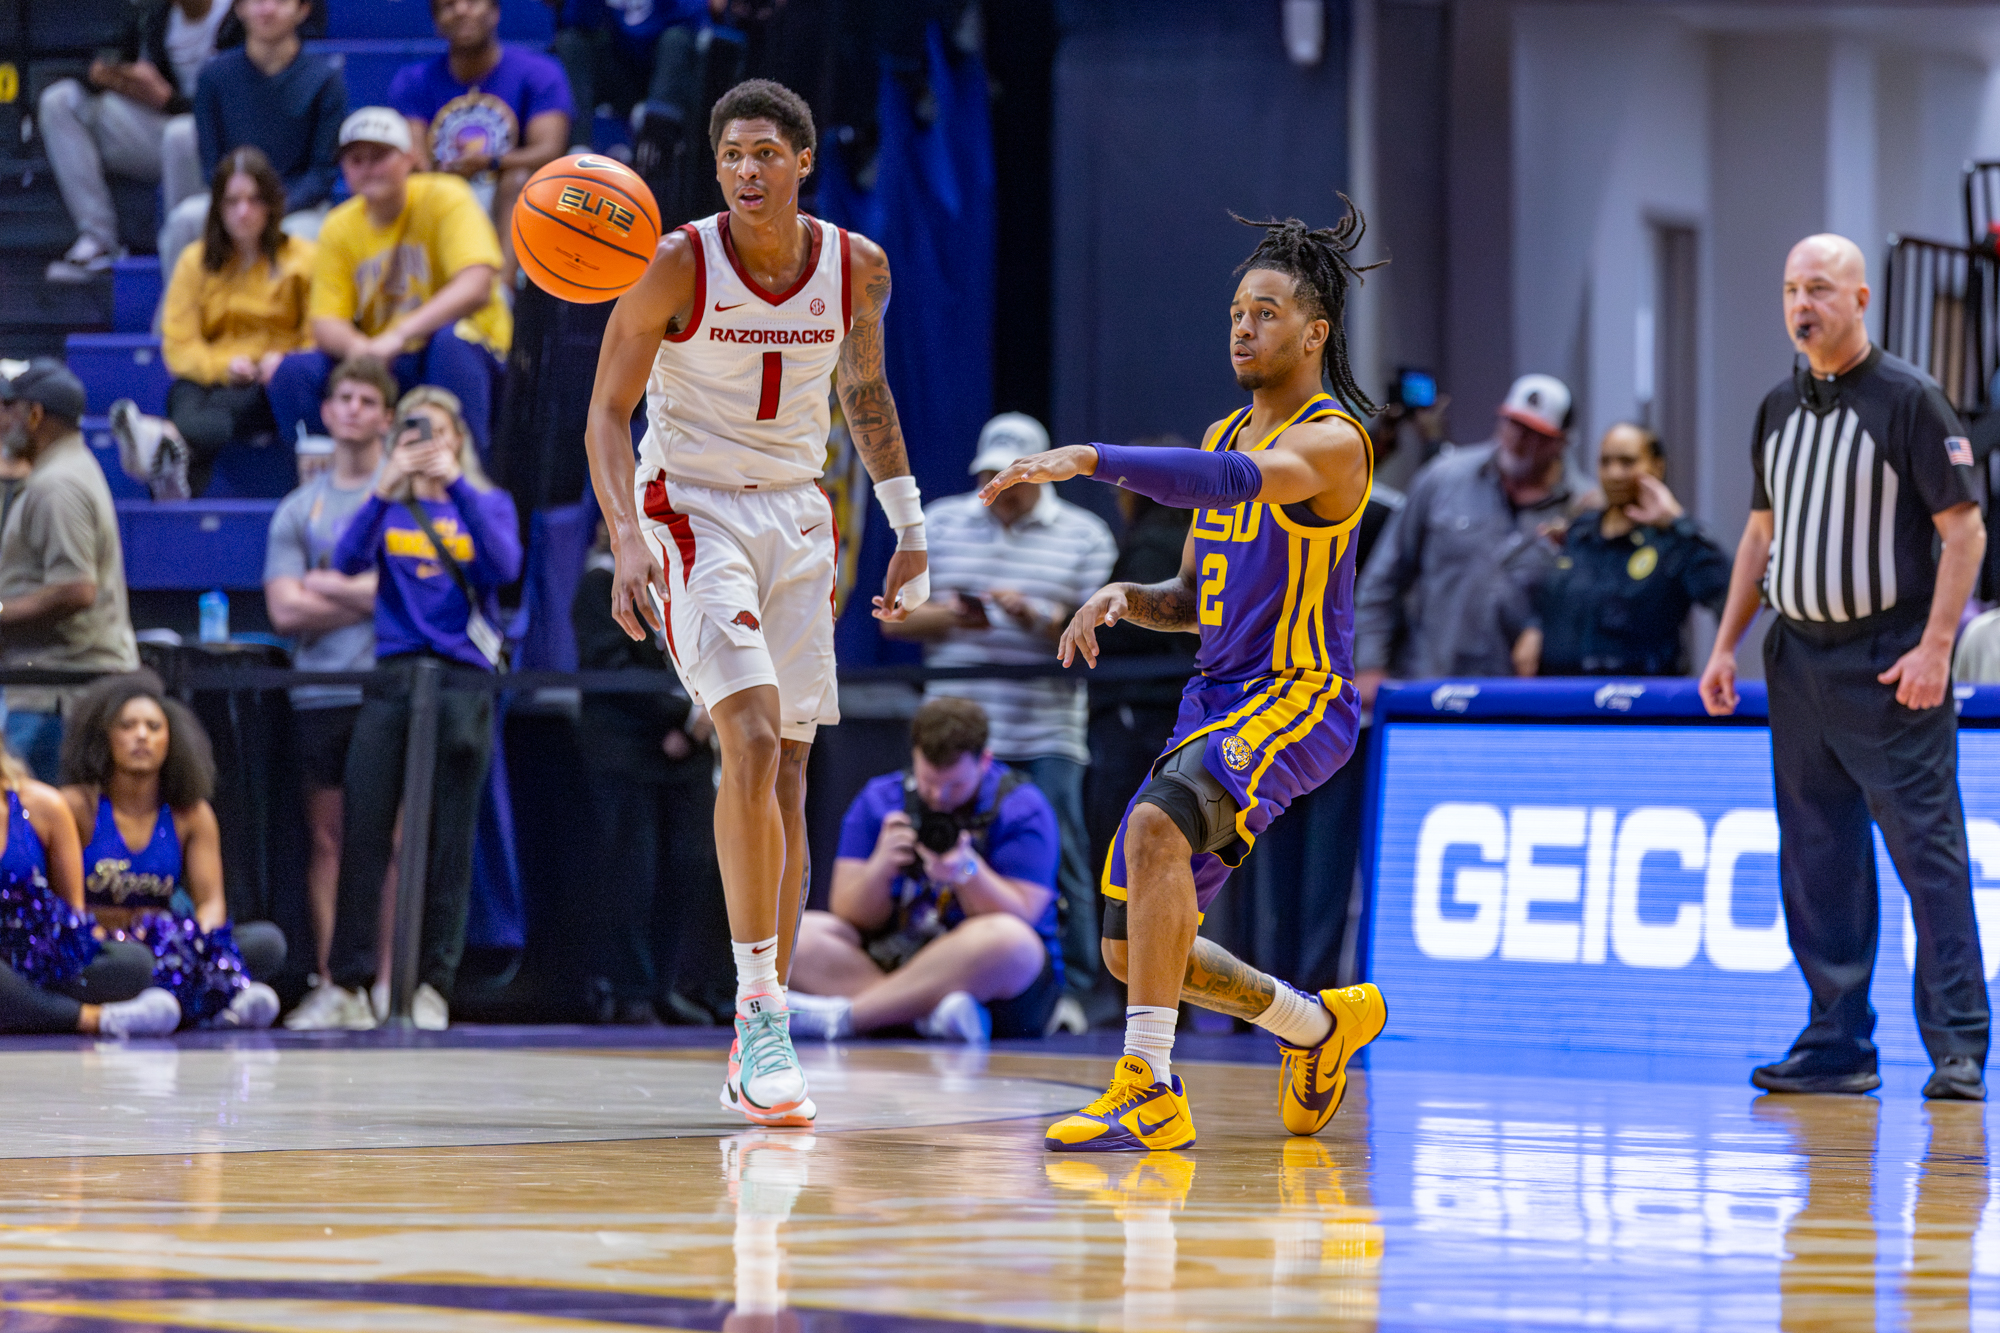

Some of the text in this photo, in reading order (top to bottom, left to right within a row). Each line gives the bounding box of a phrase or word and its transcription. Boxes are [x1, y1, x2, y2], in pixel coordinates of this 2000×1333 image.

[558, 184, 636, 232] ELITE
[810, 298, 825, 316] SEC
[709, 326, 835, 344] RAZORBACKS
[756, 351, 782, 421] 1
[1193, 501, 1263, 542] LSU
[1199, 552, 1228, 627] 2
[1412, 803, 1795, 972] GEICO
[1124, 1061, 1143, 1075] LSU
